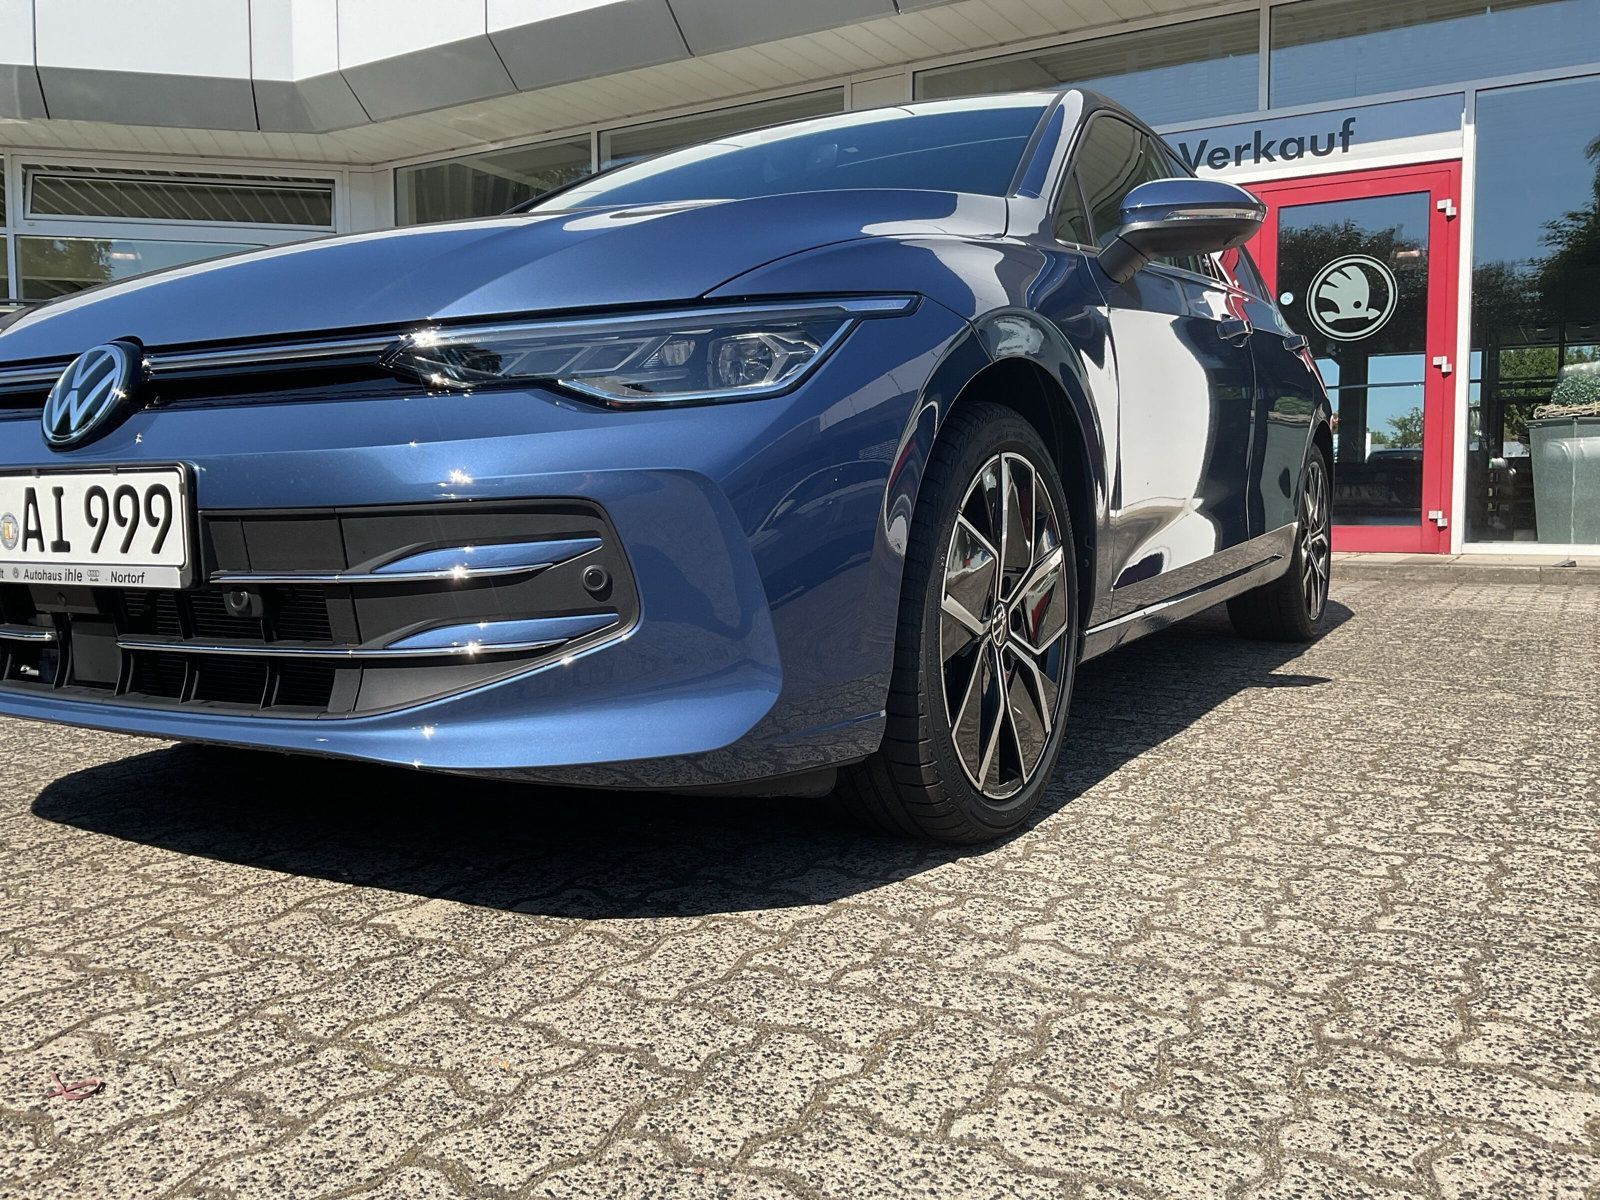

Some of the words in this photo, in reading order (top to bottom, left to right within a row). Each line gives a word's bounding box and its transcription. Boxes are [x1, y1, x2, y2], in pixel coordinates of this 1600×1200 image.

[1178, 117, 1356, 173] Verkauf
[22, 486, 71, 553] AI
[84, 484, 173, 554] 999
[23, 568, 62, 581] Autohaus
[64, 569, 83, 582] ihle
[110, 571, 145, 584] Nortorf
